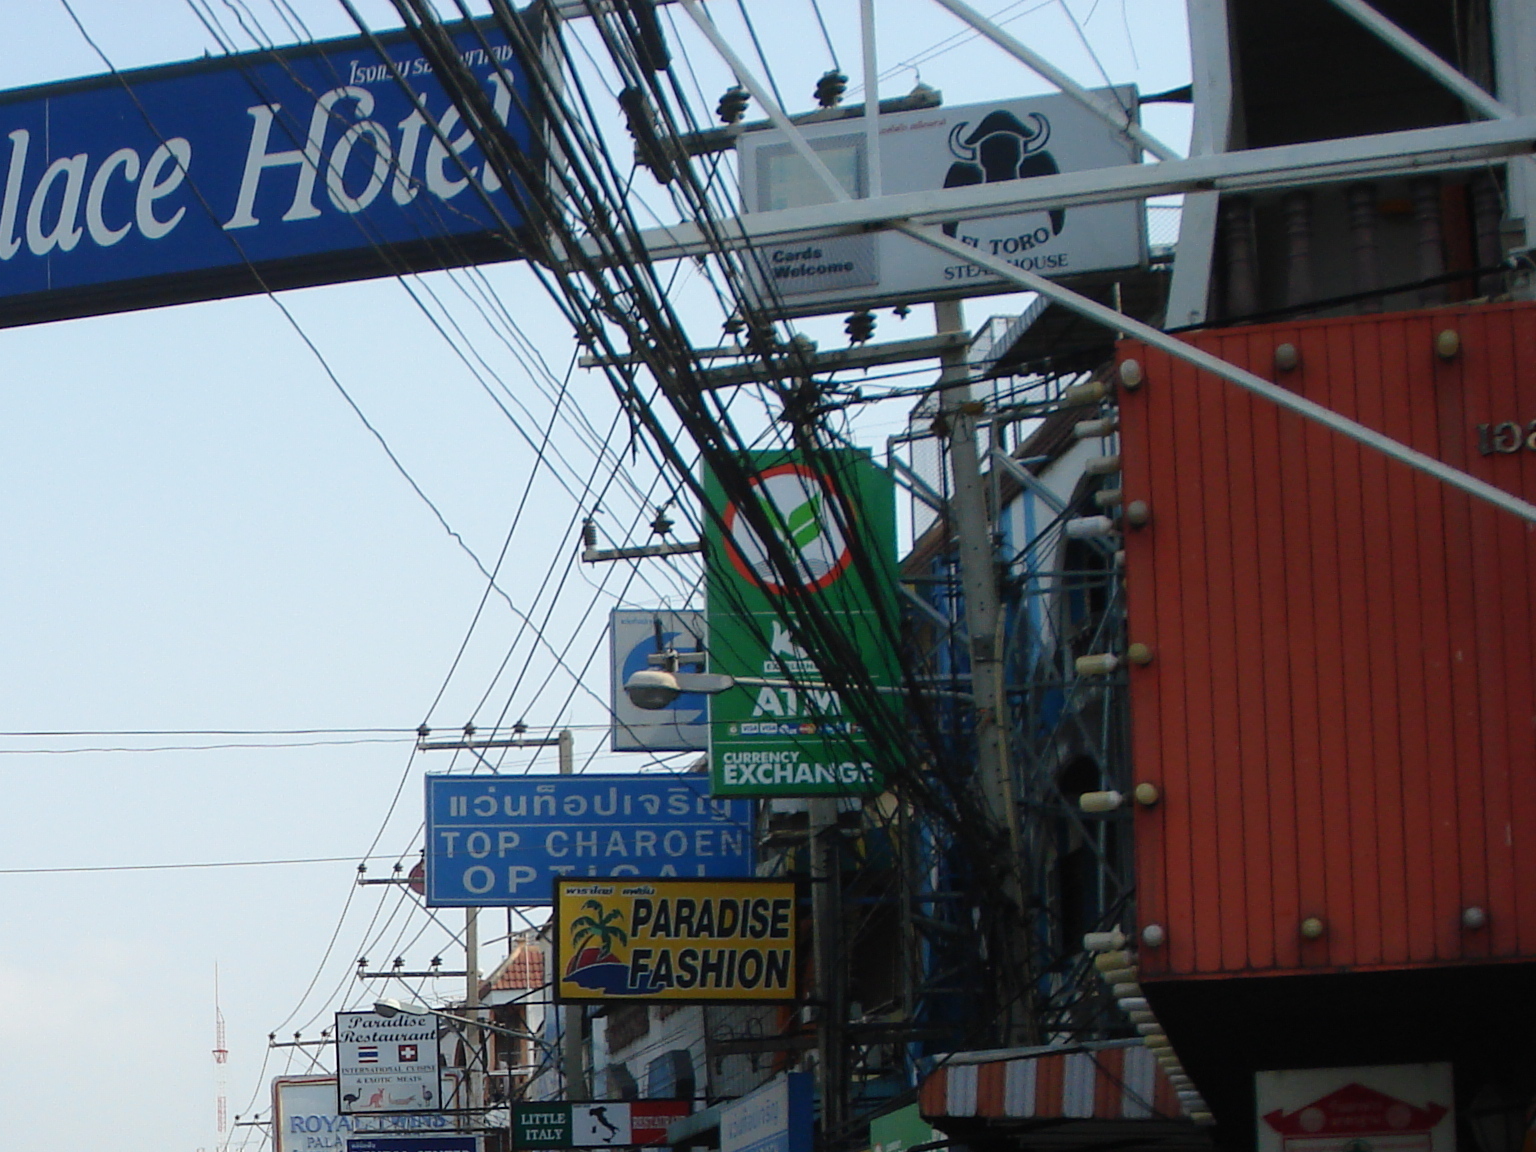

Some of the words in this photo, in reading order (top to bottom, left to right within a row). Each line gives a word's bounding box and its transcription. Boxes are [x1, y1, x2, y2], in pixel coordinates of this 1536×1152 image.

[234, 69, 514, 228] Hotel
[989, 227, 1050, 255] TORO
[773, 247, 823, 263] Cards
[774, 260, 854, 279] Welcome
[753, 686, 843, 716] ATM
[724, 752, 799, 764] CURRENCY
[724, 763, 873, 785] EXCHANGE
[440, 831, 520, 858] TOP
[546, 830, 742, 858] CHAROEN
[630, 899, 792, 938] PARADISE
[628, 949, 792, 989] FASHION
[348, 1015, 426, 1029] Paradise
[340, 1029, 437, 1043] Restaurant
[290, 1115, 366, 1134] ROYAL
[521, 1113, 565, 1125] LITTLE
[526, 1129, 563, 1141] ITALY
